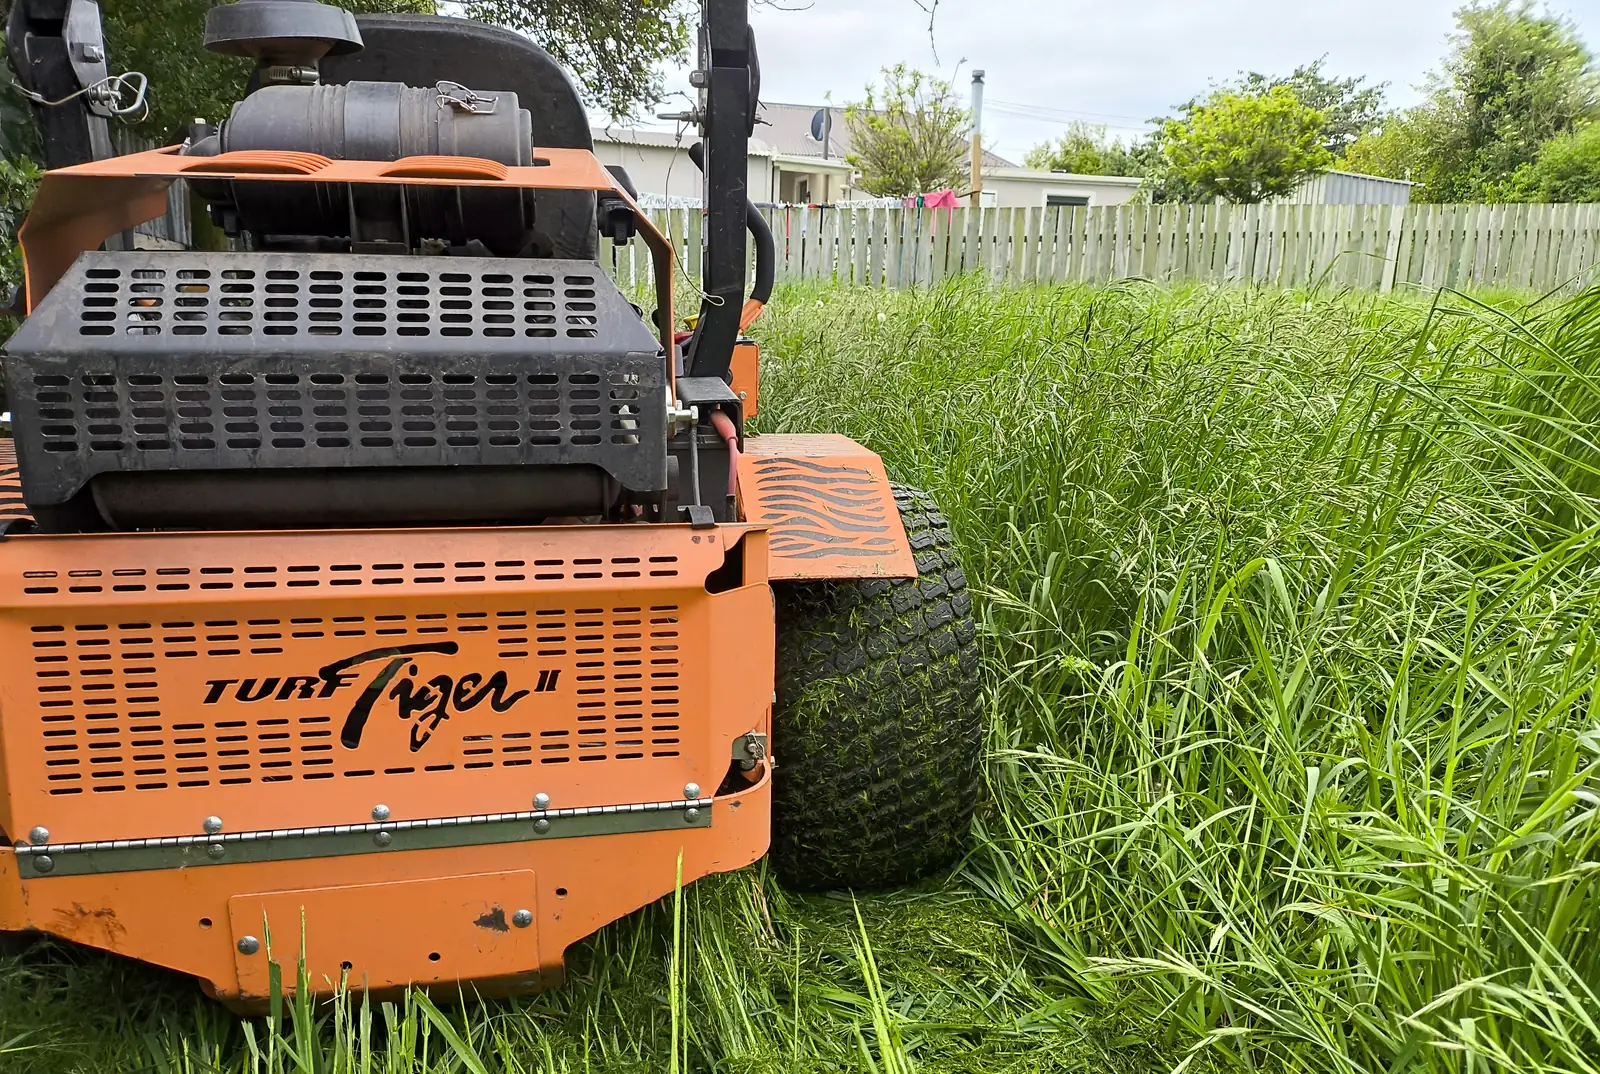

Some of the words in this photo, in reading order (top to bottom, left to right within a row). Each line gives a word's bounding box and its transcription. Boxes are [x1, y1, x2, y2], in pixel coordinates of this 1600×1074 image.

[203, 673, 360, 704] TURF
[319, 641, 530, 752] Tiger
[534, 669, 561, 692] II
